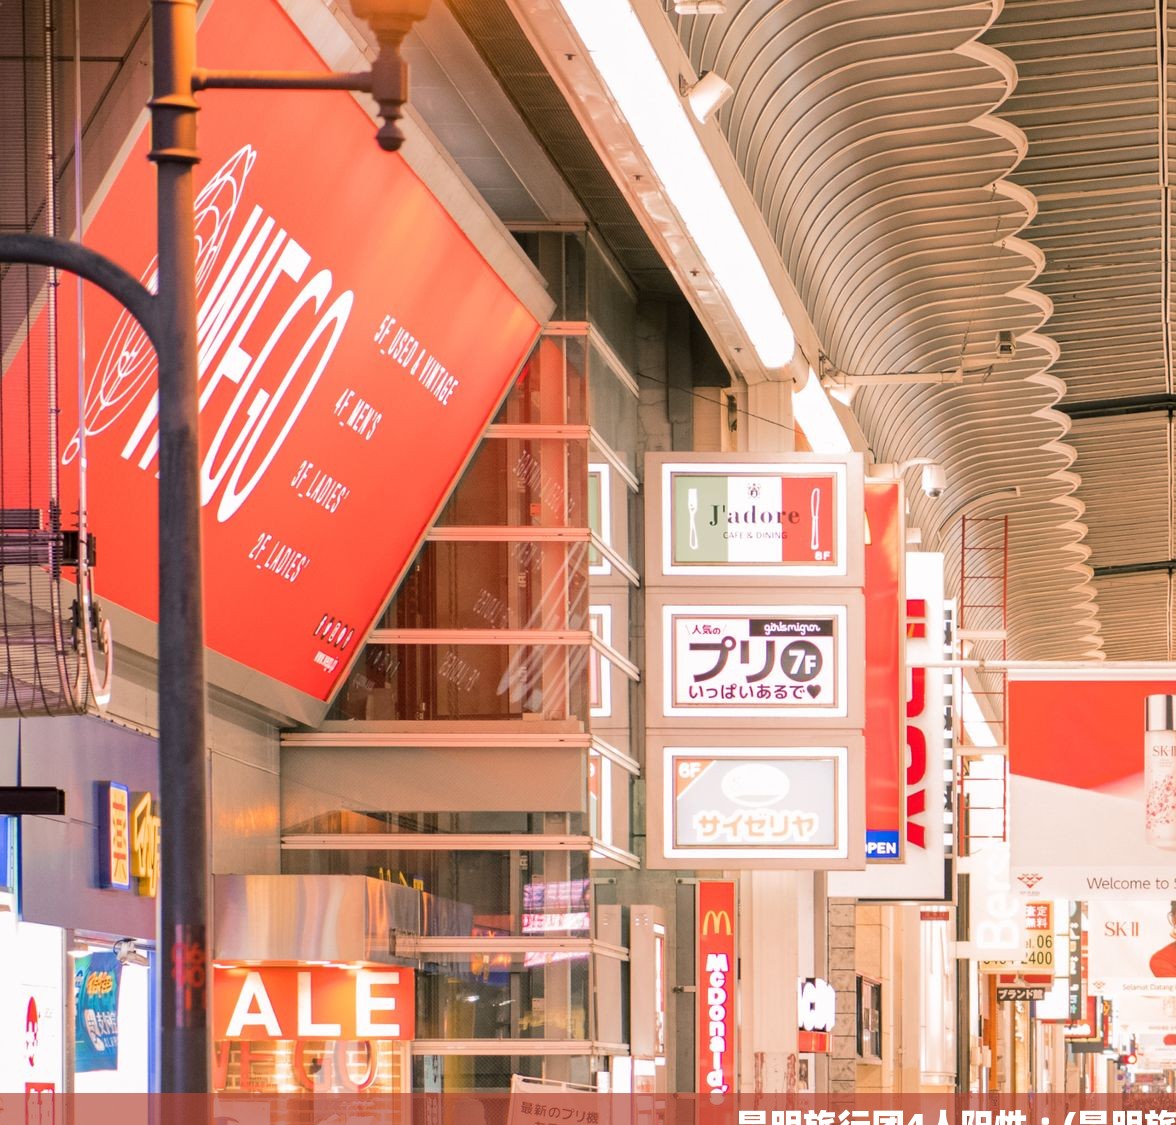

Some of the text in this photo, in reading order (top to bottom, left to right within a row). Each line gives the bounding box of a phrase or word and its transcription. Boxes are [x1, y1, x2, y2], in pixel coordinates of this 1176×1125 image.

[418, 354, 459, 405] VINTAGE
[709, 504, 800, 526] J'adore
[723, 531, 745, 540] CAFE
[754, 531, 788, 540] DINING
[692, 624, 721, 635] 人気の
[689, 636, 817, 683] プリ 7F
[688, 683, 805, 700] いっぱいあるで
[679, 763, 701, 779] 6F
[698, 814, 816, 838] サイゼリヤ
[865, 843, 896, 855] PEN
[1087, 877, 1150, 890] Welcome
[1156, 878, 1169, 890] to
[1037, 935, 1053, 948] 06
[998, 989, 1044, 1000] ブランド館
[225, 971, 400, 1037] ALE
[705, 953, 729, 1105] McDonald's
[521, 1101, 599, 1125] 最新のプリ機
